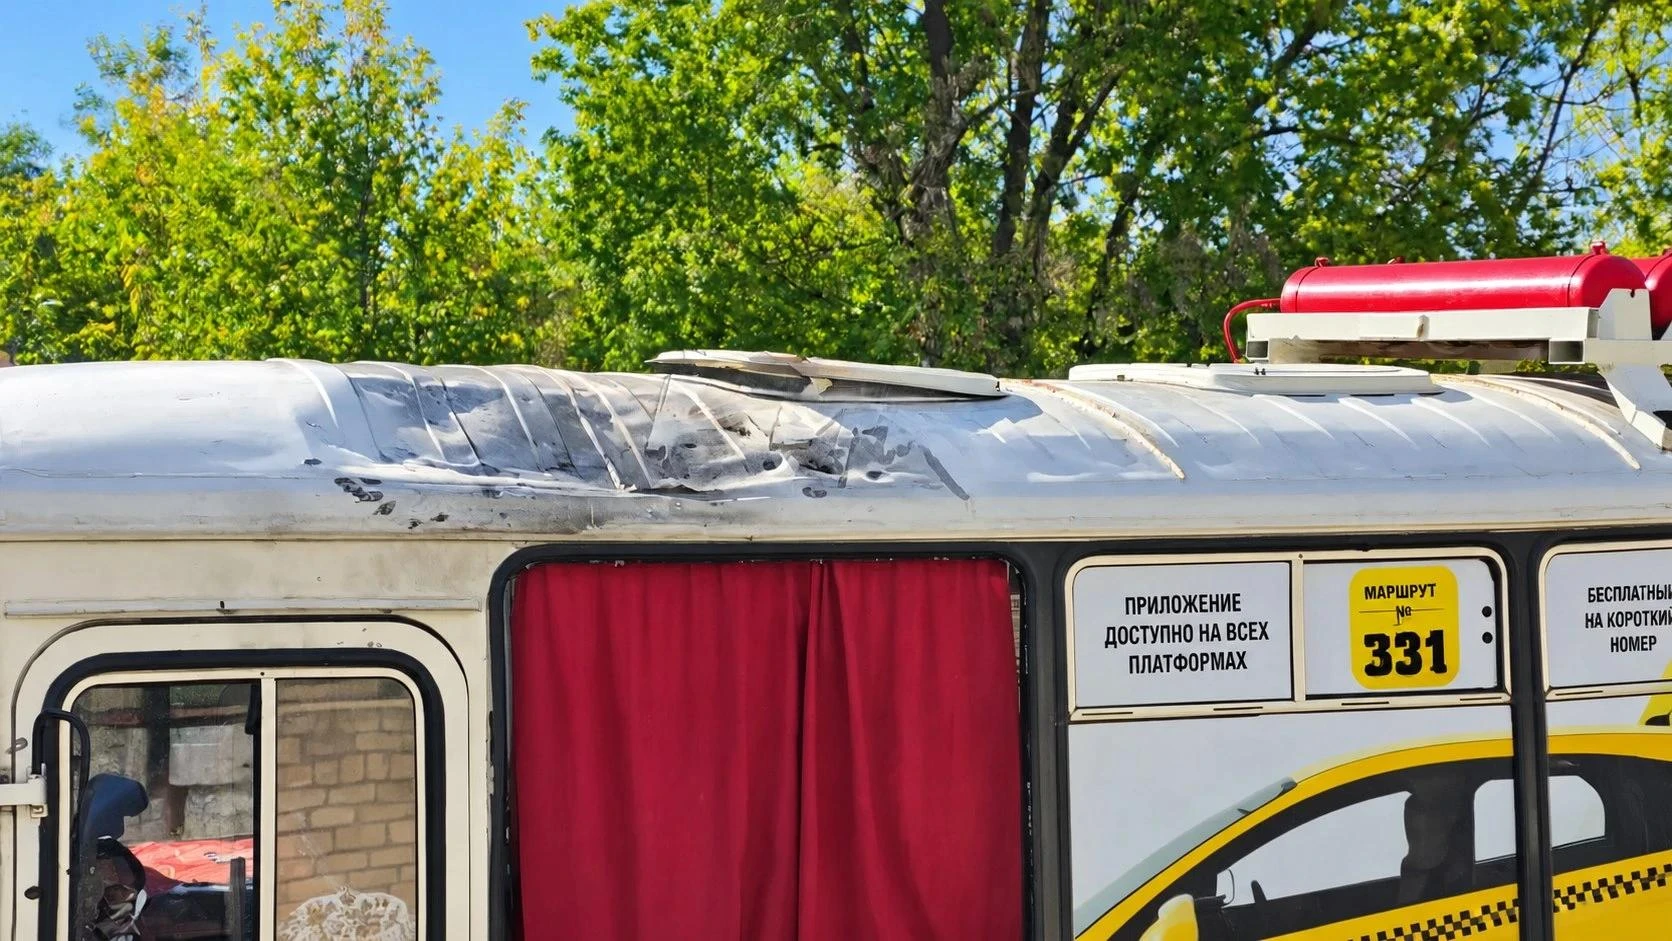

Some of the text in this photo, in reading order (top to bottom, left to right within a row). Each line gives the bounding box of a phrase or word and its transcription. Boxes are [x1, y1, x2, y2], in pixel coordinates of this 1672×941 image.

[1364, 583, 1437, 600] МАРШРУТ
[1125, 592, 1242, 616] ПРИЛОЖЕНИЕ
[1585, 612, 1604, 628] НА
[1104, 621, 1270, 649] ДОСТУПНО НА ВСЕХ
[1610, 635, 1657, 653] НОМЕР
[1129, 651, 1248, 675] ПЛАТФОРМАХ
[1363, 629, 1447, 677] 331
